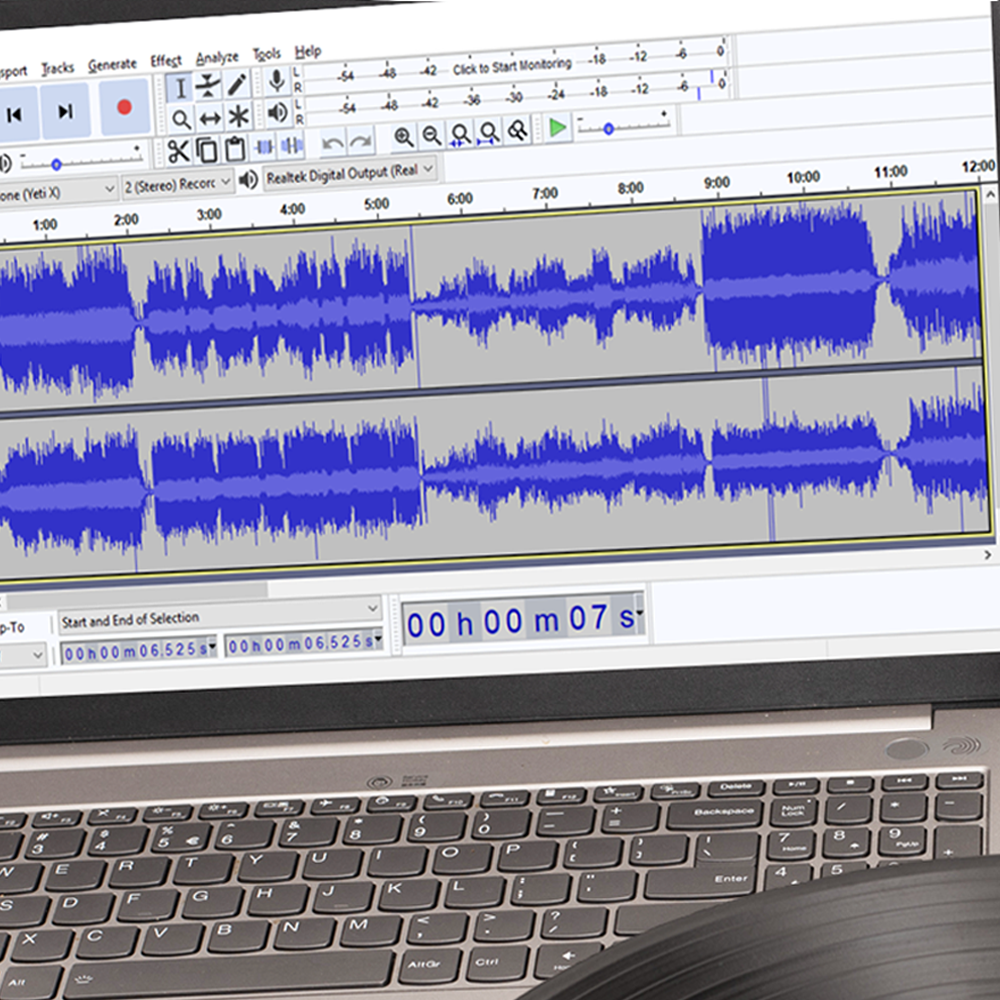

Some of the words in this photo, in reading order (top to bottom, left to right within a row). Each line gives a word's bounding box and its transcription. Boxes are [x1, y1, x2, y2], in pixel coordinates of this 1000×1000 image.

[41, 62, 75, 77] Tracks
[88, 57, 137, 74] Generate
[150, 54, 182, 69] Effect
[196, 51, 239, 67] Analyze
[252, 47, 281, 62] Tools
[294, 45, 322, 60] Help
[337, 71, 354, 82] -54
[378, 68, 397, 79] -48
[419, 65, 437, 76] -42
[453, 63, 477, 76] Click
[479, 64, 490, 74] to
[492, 60, 517, 73] Start
[520, 57, 572, 71] Monitoring
[588, 53, 606, 65] -18
[629, 50, 647, 62] -12
[675, 48, 687, 59] -6
[717, 45, 724, 57] 0
[293, 67, 299, 77] L
[294, 82, 302, 93] R
[338, 103, 356, 114] -54
[380, 100, 399, 111] -48
[421, 97, 439, 109] -42
[505, 91, 523, 103] -30
[548, 89, 565, 100] -24
[589, 86, 608, 98] -18
[631, 83, 649, 95] -12
[677, 80, 689, 92] -6
[718, 78, 726, 89] 0
[295, 99, 301, 109] L
[296, 115, 304, 125] R
[266, 170, 307, 185] Realtek
[310, 167, 345, 184] Digital
[348, 164, 389, 180] Output
[391, 163, 418, 178] (Real
[125, 181, 132, 194] 2
[135, 179, 177, 195] (Stereo)
[22, 187, 47, 202] (Yeti
[48, 186, 61, 200] X)
[33, 218, 58, 231] 1:00
[114, 213, 139, 226] 2:00
[197, 208, 222, 221] 3:00
[280, 202, 306, 215] 4:00
[364, 197, 390, 210] 5:00
[447, 192, 473, 205] 6:00
[532, 187, 559, 199] 7:00
[618, 181, 644, 194] 8:00
[704, 175, 730, 189] 9:00
[787, 170, 821, 183] 10:00
[874, 164, 908, 178] 11:00
[962, 159, 996, 173] 12:00
[62, 616, 87, 629] Start
[90, 615, 110, 627] and
[112, 613, 134, 626] End
[136, 612, 148, 625] of
[150, 611, 200, 625] Selection
[407, 611, 446, 638] 00
[457, 611, 473, 636] h
[484, 608, 522, 635] 00
[535, 611, 559, 632] m
[569, 604, 608, 631] 07
[619, 608, 635, 628] s
[229, 639, 248, 654] 00
[252, 640, 261, 652] h
[265, 638, 284, 652] 00
[288, 639, 301, 650] m
[365, 636, 373, 647] s
[65, 647, 84, 661] 00
[88, 646, 96, 660] h
[100, 645, 119, 659] 00
[124, 647, 136, 658] m
[200, 644, 207, 655] s
[719, 782, 752, 790] Delete
[694, 807, 755, 817] Backspace
[781, 810, 805, 818] Lock
[413, 826, 426, 837] 9
[477, 824, 490, 834] 0
[889, 828, 901, 839] 9
[221, 834, 233, 845] 6
[286, 832, 298, 842] 7
[349, 830, 361, 840] 8
[779, 832, 790, 843] 7
[833, 830, 845, 841] 8
[95, 841, 106, 851] 4
[157, 838, 169, 848] 5
[31, 844, 44, 855] 3
[375, 849, 382, 860] I
[441, 846, 459, 858] O
[506, 844, 520, 854] P
[185, 857, 199, 868] T
[250, 854, 263, 865] Y
[312, 853, 328, 863] U
[55, 864, 70, 874] E
[118, 861, 134, 871] R
[831, 865, 843, 875] 5
[775, 867, 787, 877] 4
[714, 874, 748, 883] Enter
[322, 886, 335, 896] J
[387, 883, 403, 894] K
[453, 881, 465, 891] L
[126, 893, 141, 904] F
[192, 890, 209, 902] G
[256, 888, 273, 898] H
[0, 900, 14, 911] S
[62, 897, 79, 908] D
[217, 925, 232, 935] B
[283, 921, 301, 931] N
[349, 919, 368, 930] M
[87, 930, 103, 941] C
[153, 927, 168, 938] V
[21, 933, 38, 945] X
[407, 960, 441, 969] AltGr
[475, 958, 499, 967] Ctrl
[8, 978, 26, 987] Alt
